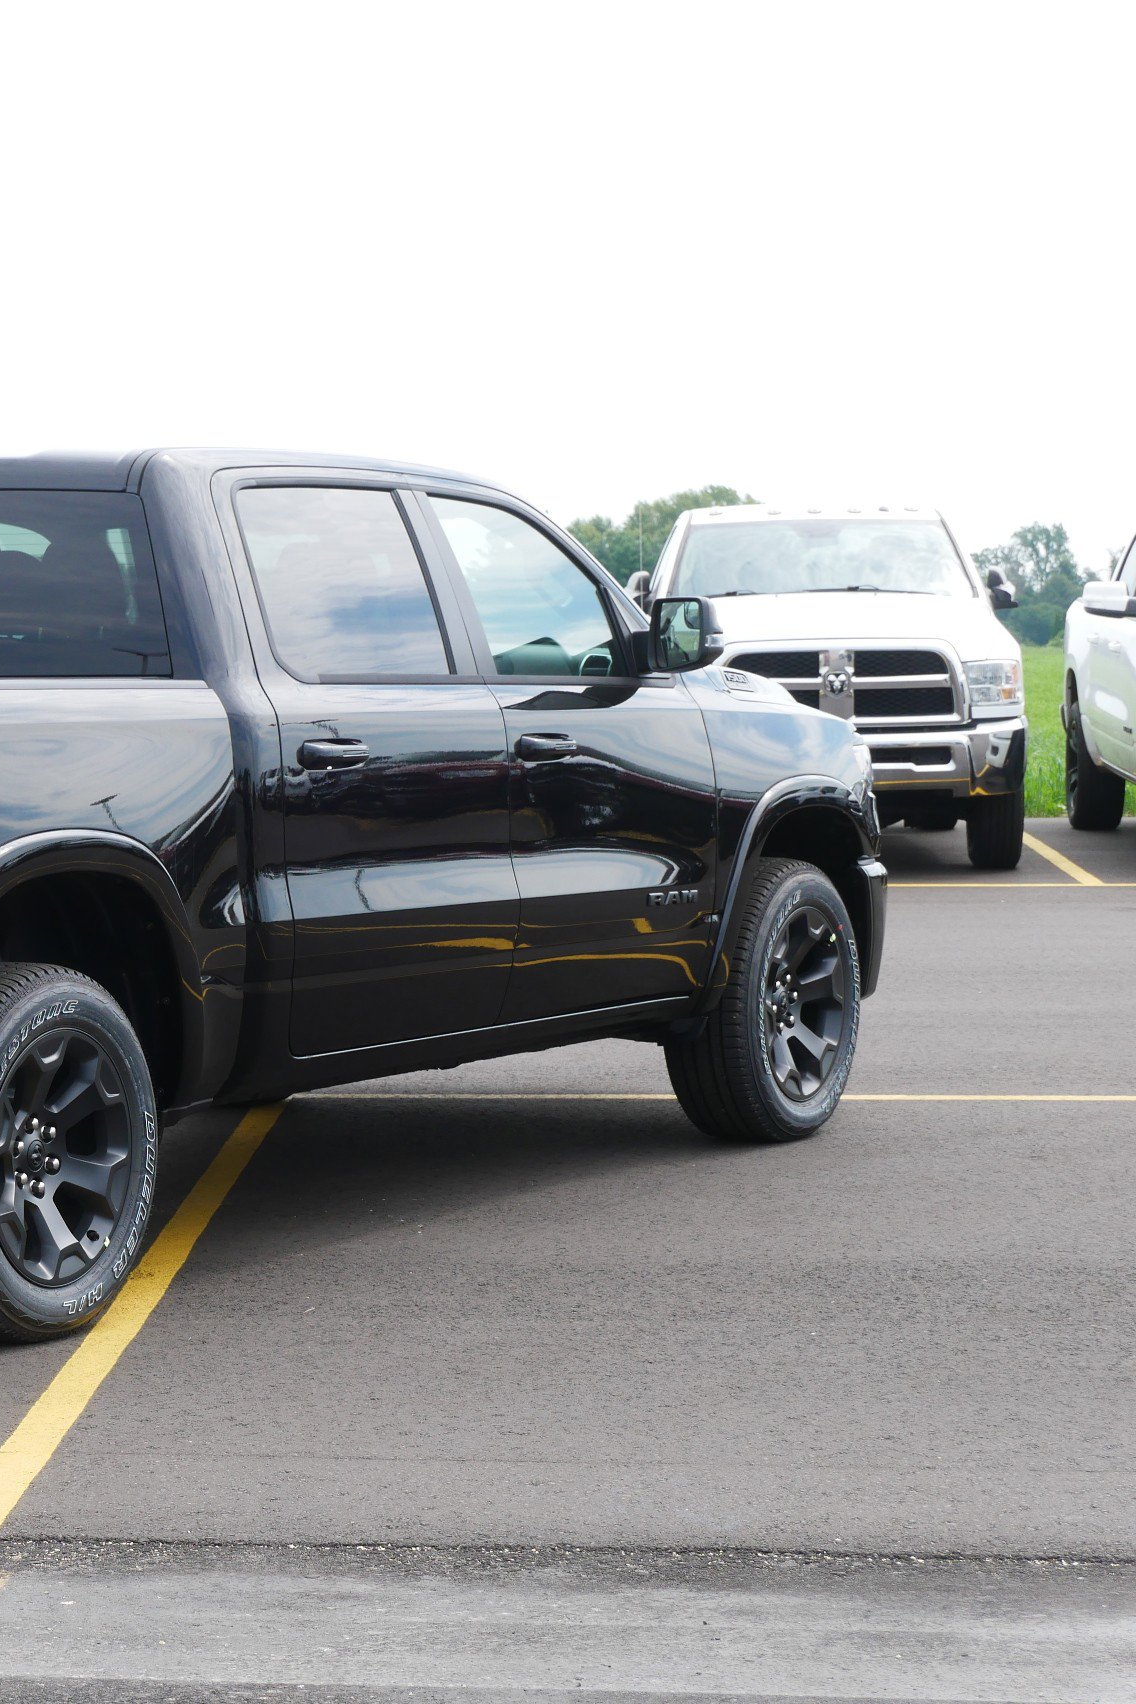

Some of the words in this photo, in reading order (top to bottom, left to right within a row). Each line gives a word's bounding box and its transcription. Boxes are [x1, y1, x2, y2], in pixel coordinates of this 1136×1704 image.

[647, 889, 699, 907] RAM
[113, 1111, 156, 1279] DUELER
[63, 1283, 104, 1315] H/L
